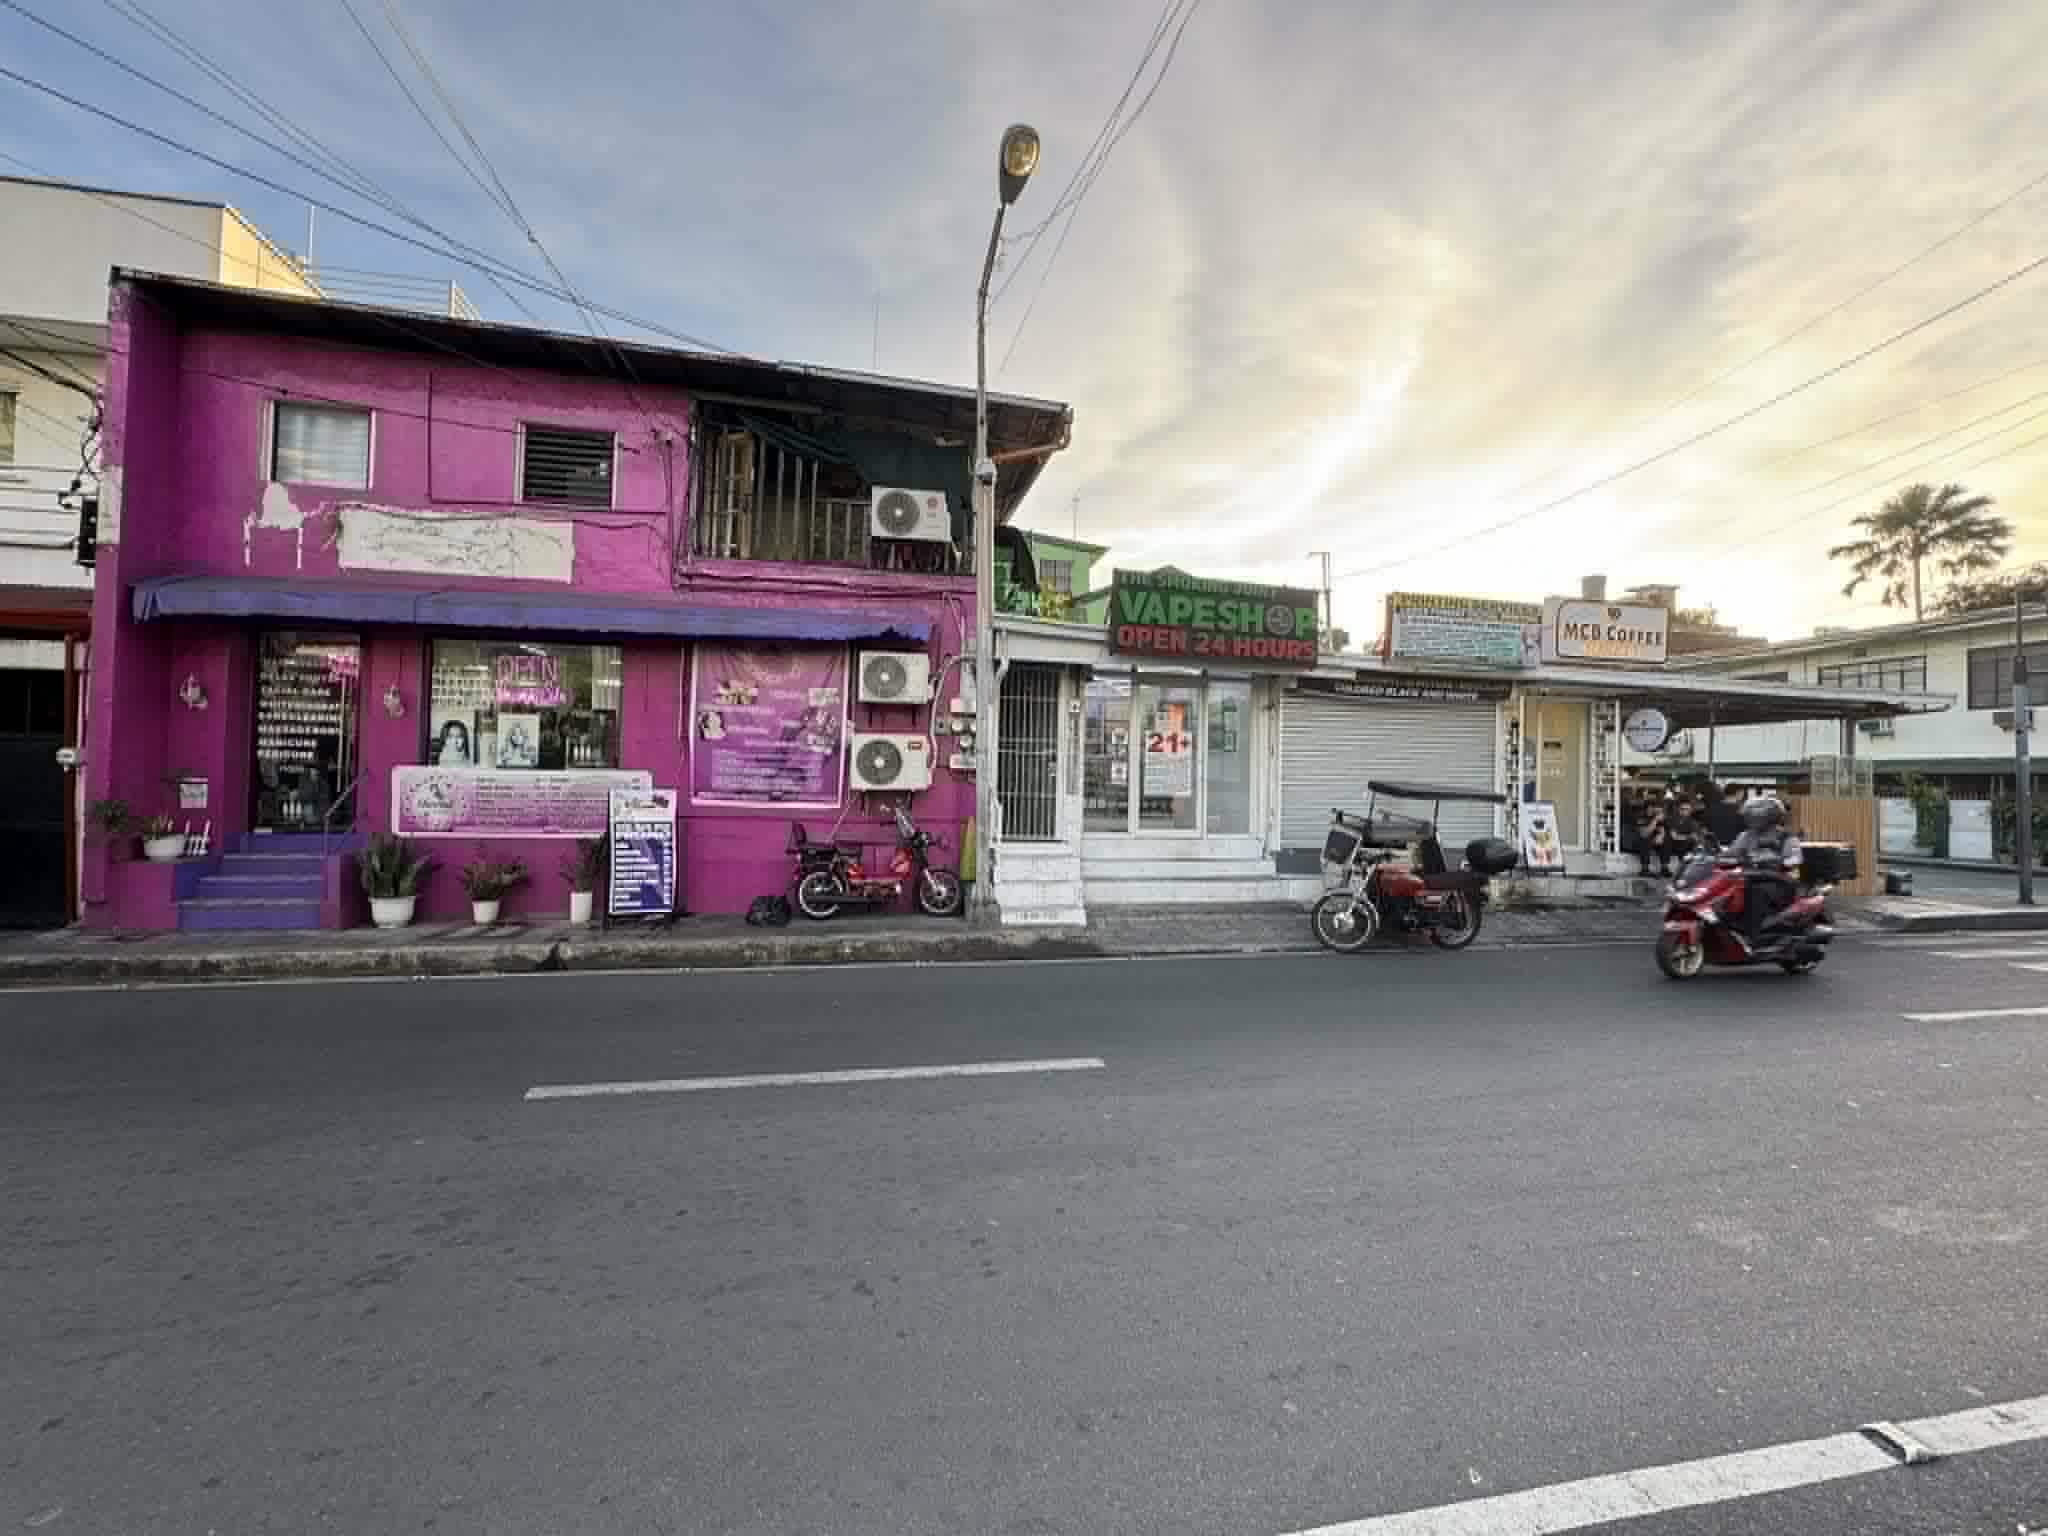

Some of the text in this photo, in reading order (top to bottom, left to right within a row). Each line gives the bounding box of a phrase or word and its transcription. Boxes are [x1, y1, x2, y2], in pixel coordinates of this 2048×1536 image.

[1118, 624, 1315, 659] OPEN 24 HOURS
[1147, 731, 1191, 753] 21+
